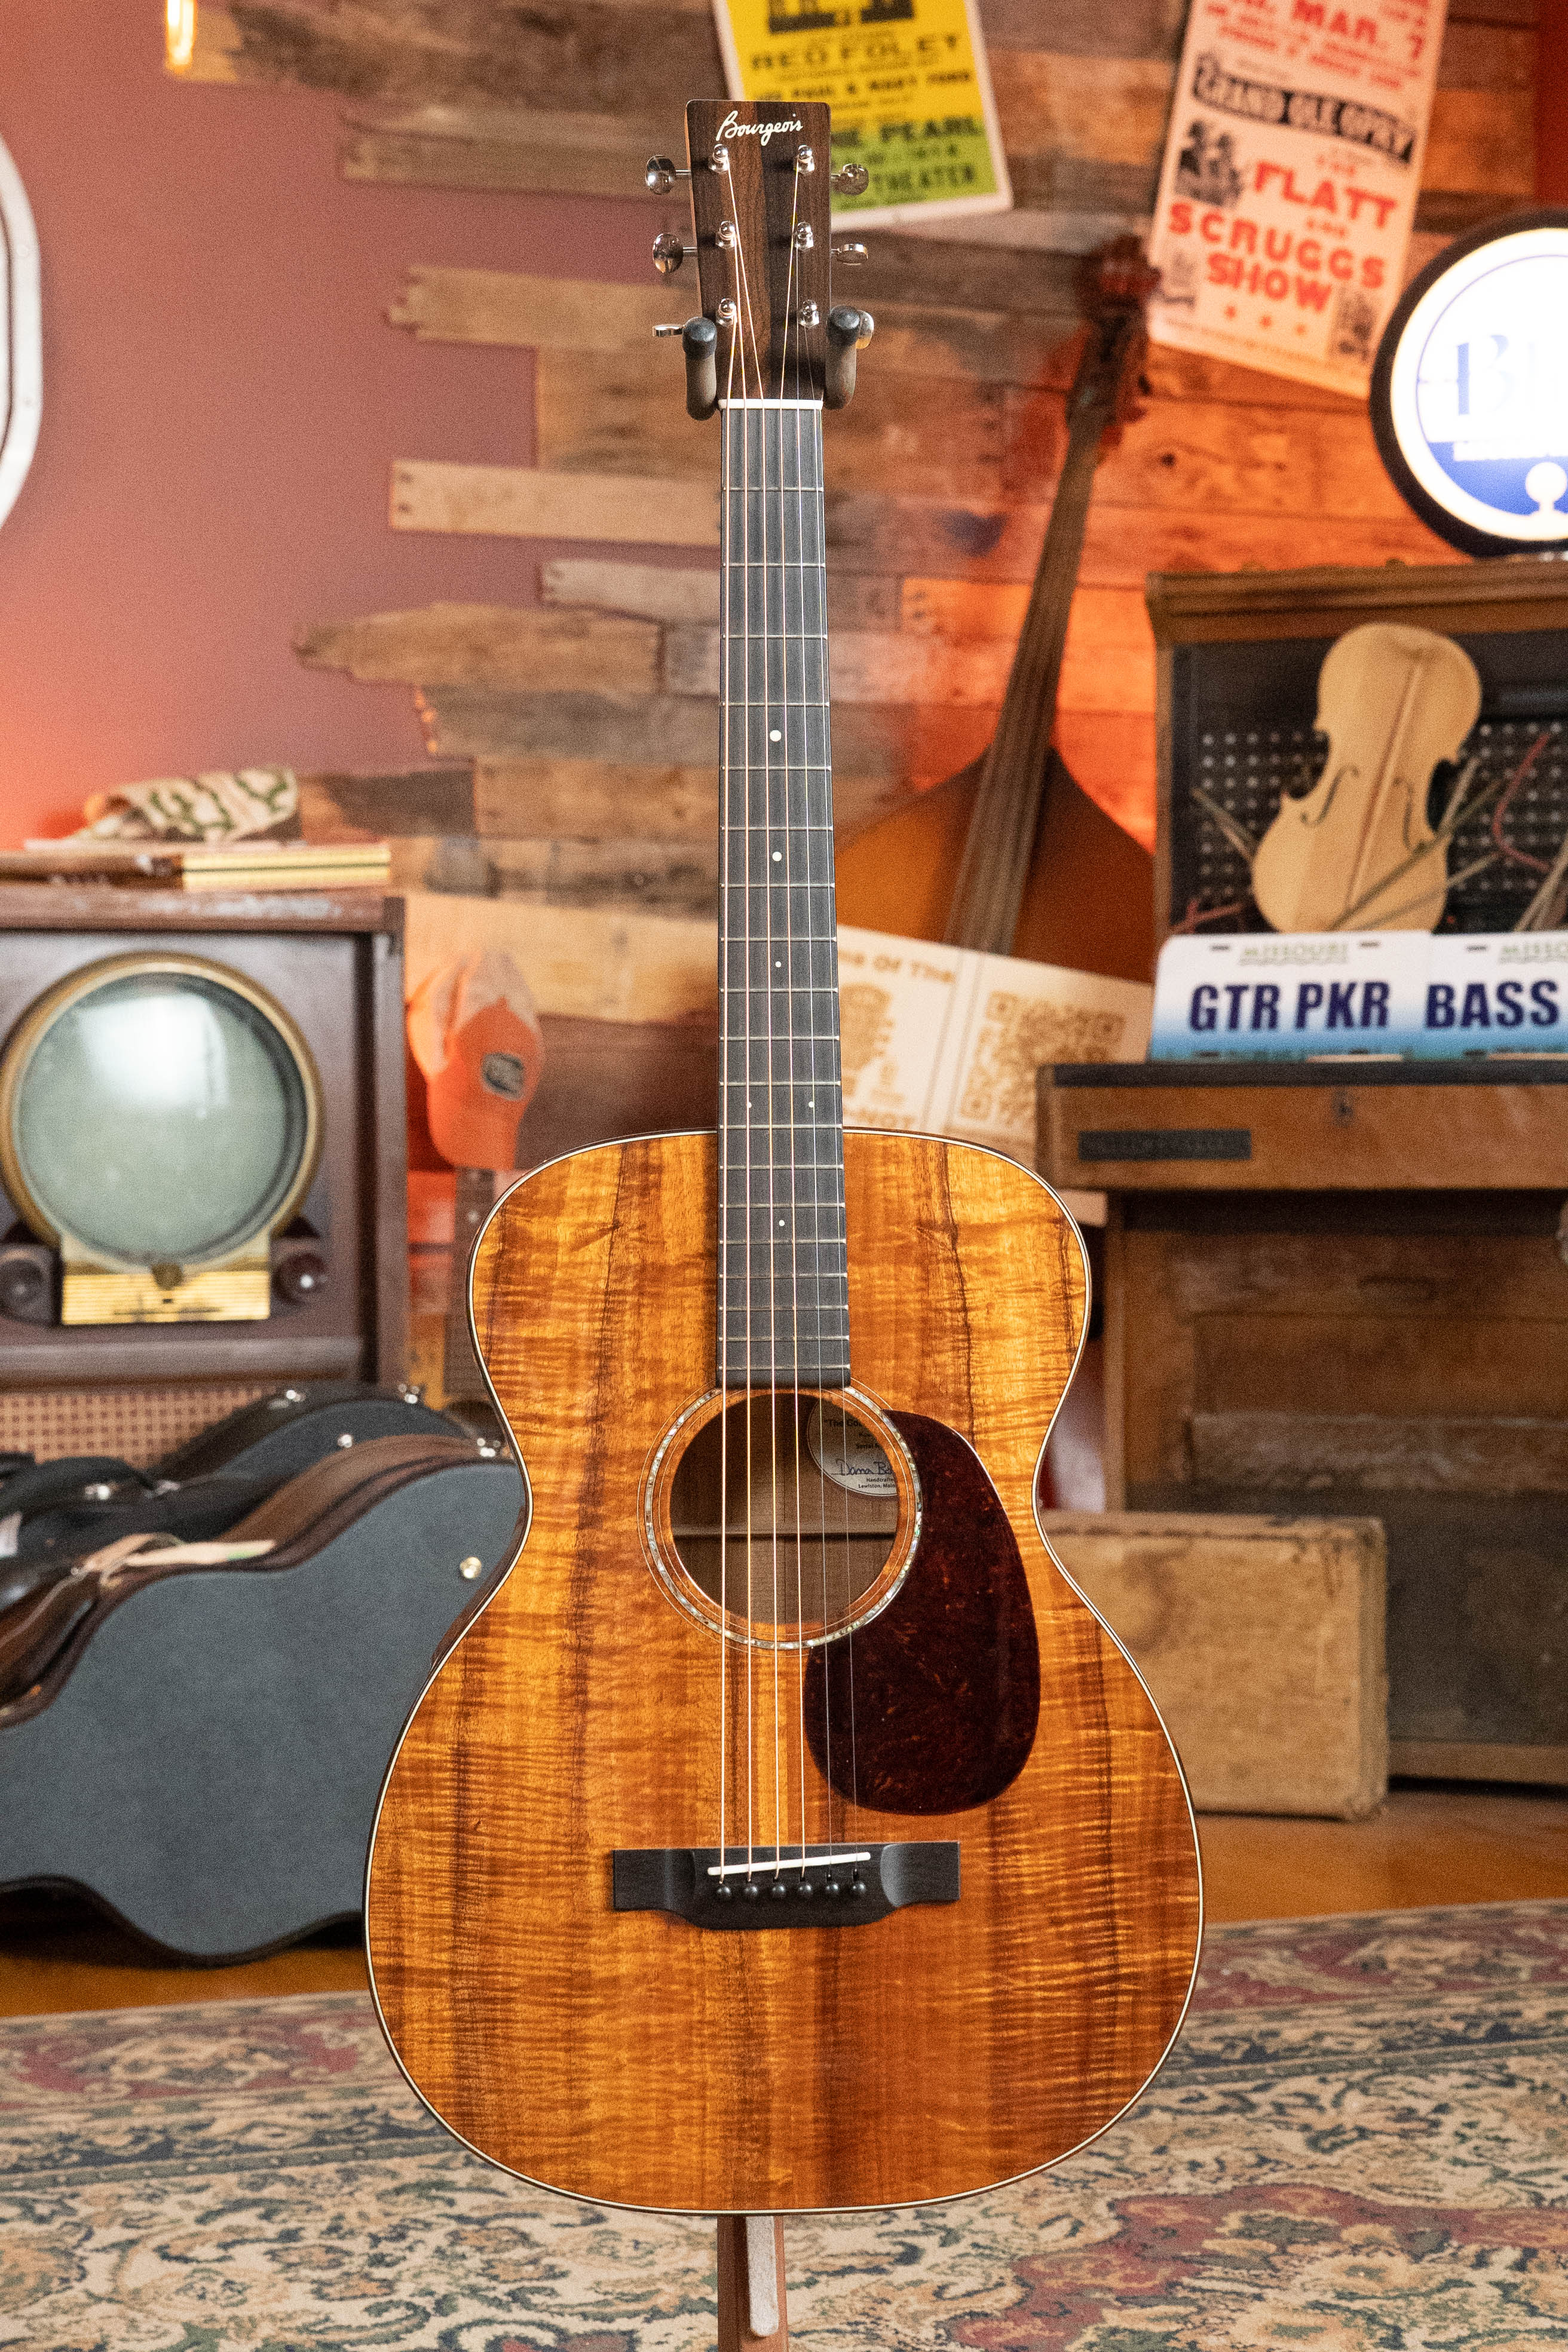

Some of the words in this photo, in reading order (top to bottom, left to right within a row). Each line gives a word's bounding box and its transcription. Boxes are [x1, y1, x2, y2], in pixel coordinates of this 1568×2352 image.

[716, 111, 803, 146] Bourgeois
[1254, 161, 1397, 229] FLATT
[1168, 202, 1386, 289] SCRUGGS
[1206, 252, 1332, 314] SHOW
[1189, 982, 1281, 1031] GTR
[1294, 981, 1390, 1030] PKR
[1426, 979, 1560, 1029] BASS
